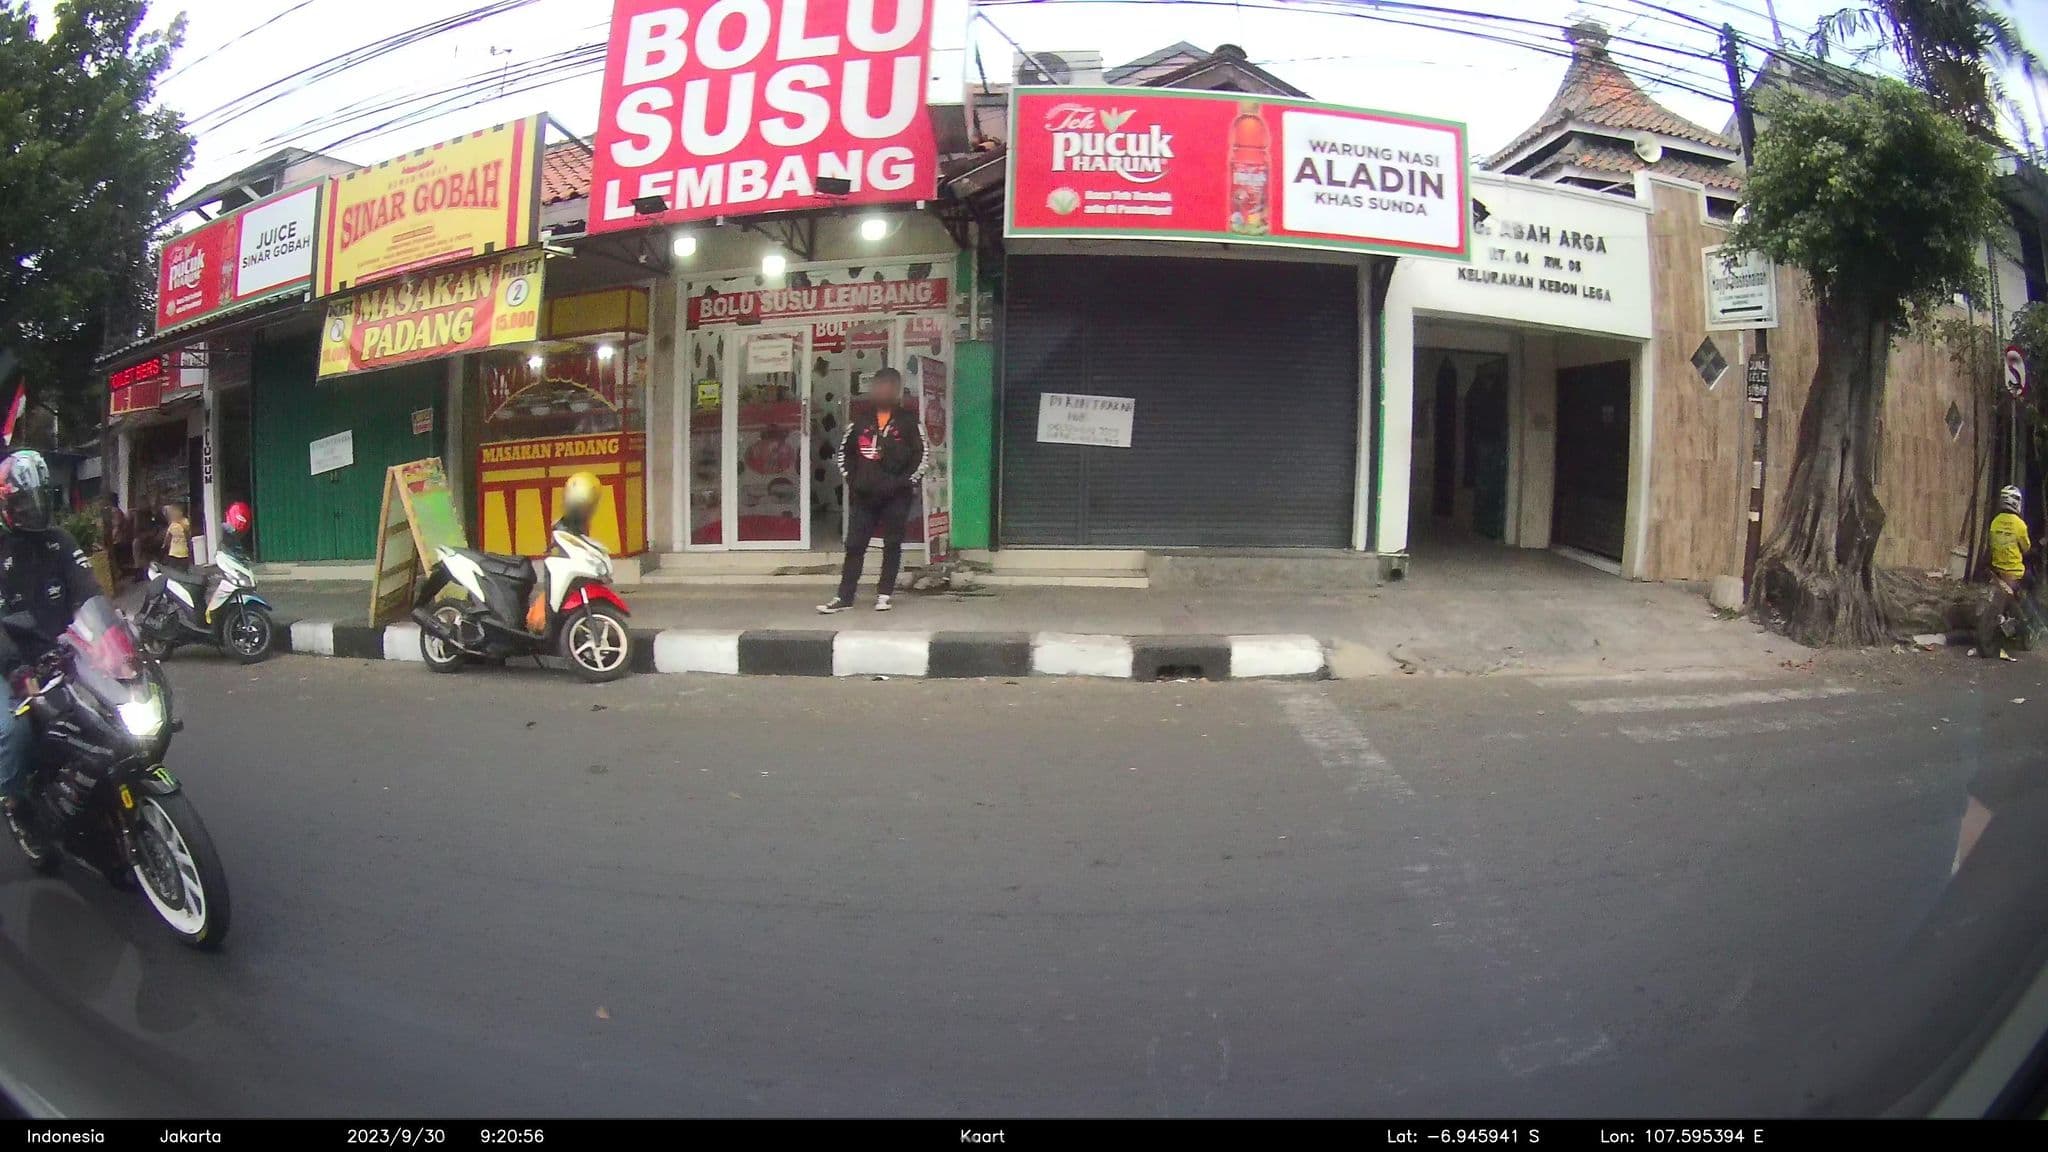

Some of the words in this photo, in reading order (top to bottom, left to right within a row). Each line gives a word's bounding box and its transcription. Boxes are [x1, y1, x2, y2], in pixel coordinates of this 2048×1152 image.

[622, 0, 923, 86] BOLU
[610, 56, 921, 167] SUSU
[1308, 139, 1392, 161] WARUNG
[1398, 150, 1439, 167] NASI
[603, 146, 915, 220] LEMBANG
[1293, 157, 1444, 199] ALADIN
[340, 190, 406, 250] SINAR
[413, 158, 503, 213] GOBAH
[1314, 191, 1364, 208] KHAS
[1369, 197, 1427, 216] SUNDA
[242, 250, 270, 269] SINAR
[273, 235, 310, 257] GOBAH
[256, 221, 297, 249] JUICE
[1559, 230, 1607, 253] ARGA
[357, 264, 495, 324] MASAKAN
[513, 284, 523, 301] 2
[701, 296, 754, 318] BOLU
[760, 290, 817, 312] SUSU
[824, 282, 932, 308] LEMBANG
[1539, 278, 1577, 295] KEBON
[1583, 286, 1612, 302] LEGA
[361, 307, 475, 361] PADANG
[482, 444, 552, 463] MASAKAN
[555, 438, 619, 457] PADANG
